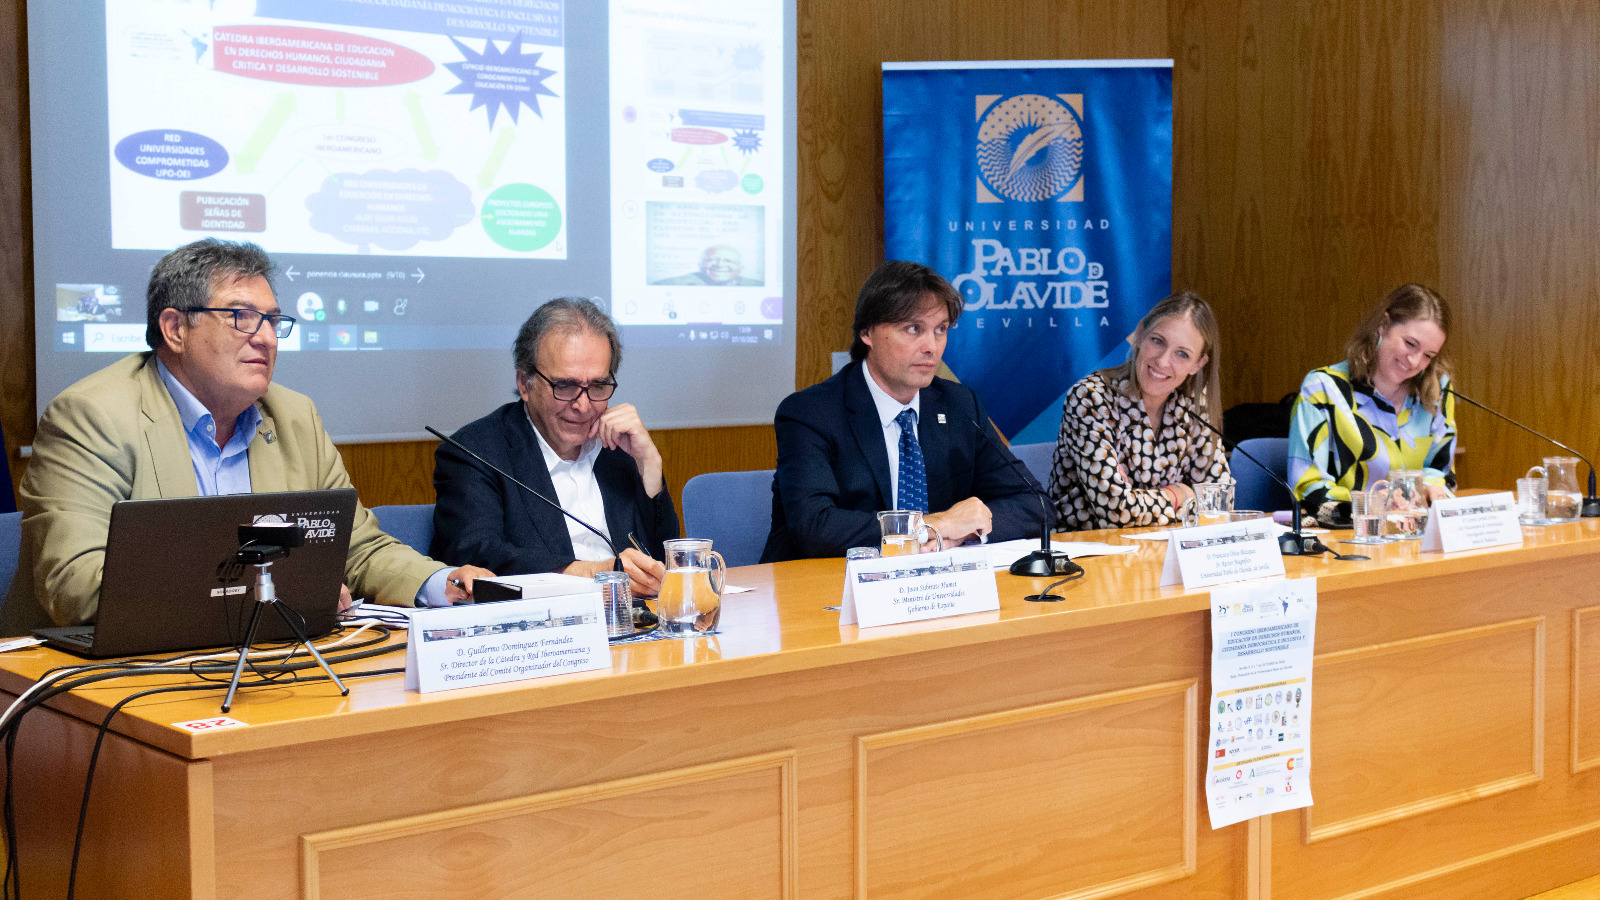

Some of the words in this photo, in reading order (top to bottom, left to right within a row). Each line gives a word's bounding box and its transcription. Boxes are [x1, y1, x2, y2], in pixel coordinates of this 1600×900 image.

[214, 32, 253, 44] CÁTEDRA
[256, 35, 332, 52] IBEROAMERICANA
[334, 44, 344, 52] DE
[348, 44, 394, 56] EDUCACIÓN
[225, 46, 236, 56] EN
[238, 48, 284, 60] DERECHOS
[268, 63, 274, 71] Y
[276, 63, 329, 77] DESARROLLO
[331, 68, 379, 80] SOSTENIBLE
[164, 134, 180, 142] RED
[336, 134, 376, 143] CONGRESO
[140, 144, 206, 156] UNIVERSIDADES
[136, 156, 209, 168] COMPROMETIDAS
[156, 170, 190, 178] UPO-OEI
[196, 195, 250, 206] PUBLICACIÓN
[204, 208, 229, 218] SEÑAS
[231, 209, 242, 218] DE
[202, 220, 245, 230] IDENTIDAD
[950, 218, 1110, 232] UNIVERSIDAD
[971, 238, 1086, 276] PABLO
[951, 272, 1110, 312] OLAVIDE
[952, 316, 1110, 329] EVILLA
[111, 334, 142, 344] Escribe
[298, 518, 330, 528] PABLO
[456, 648, 466, 656] D.
[467, 645, 500, 657] Guillermo
[502, 642, 539, 652] Domínguez
[539, 636, 574, 646] Fernández
[440, 662, 449, 672] Sr.
[450, 660, 478, 669] Director
[495, 654, 520, 664] Cátedra
[526, 652, 539, 660] Red
[540, 647, 585, 658] Iberoamericana
[444, 672, 478, 682] Presidente
[479, 669, 488, 677] del
[490, 665, 512, 676] Comité
[513, 661, 552, 674] Organizador
[552, 658, 562, 667] del
[562, 657, 590, 667] Congreso
